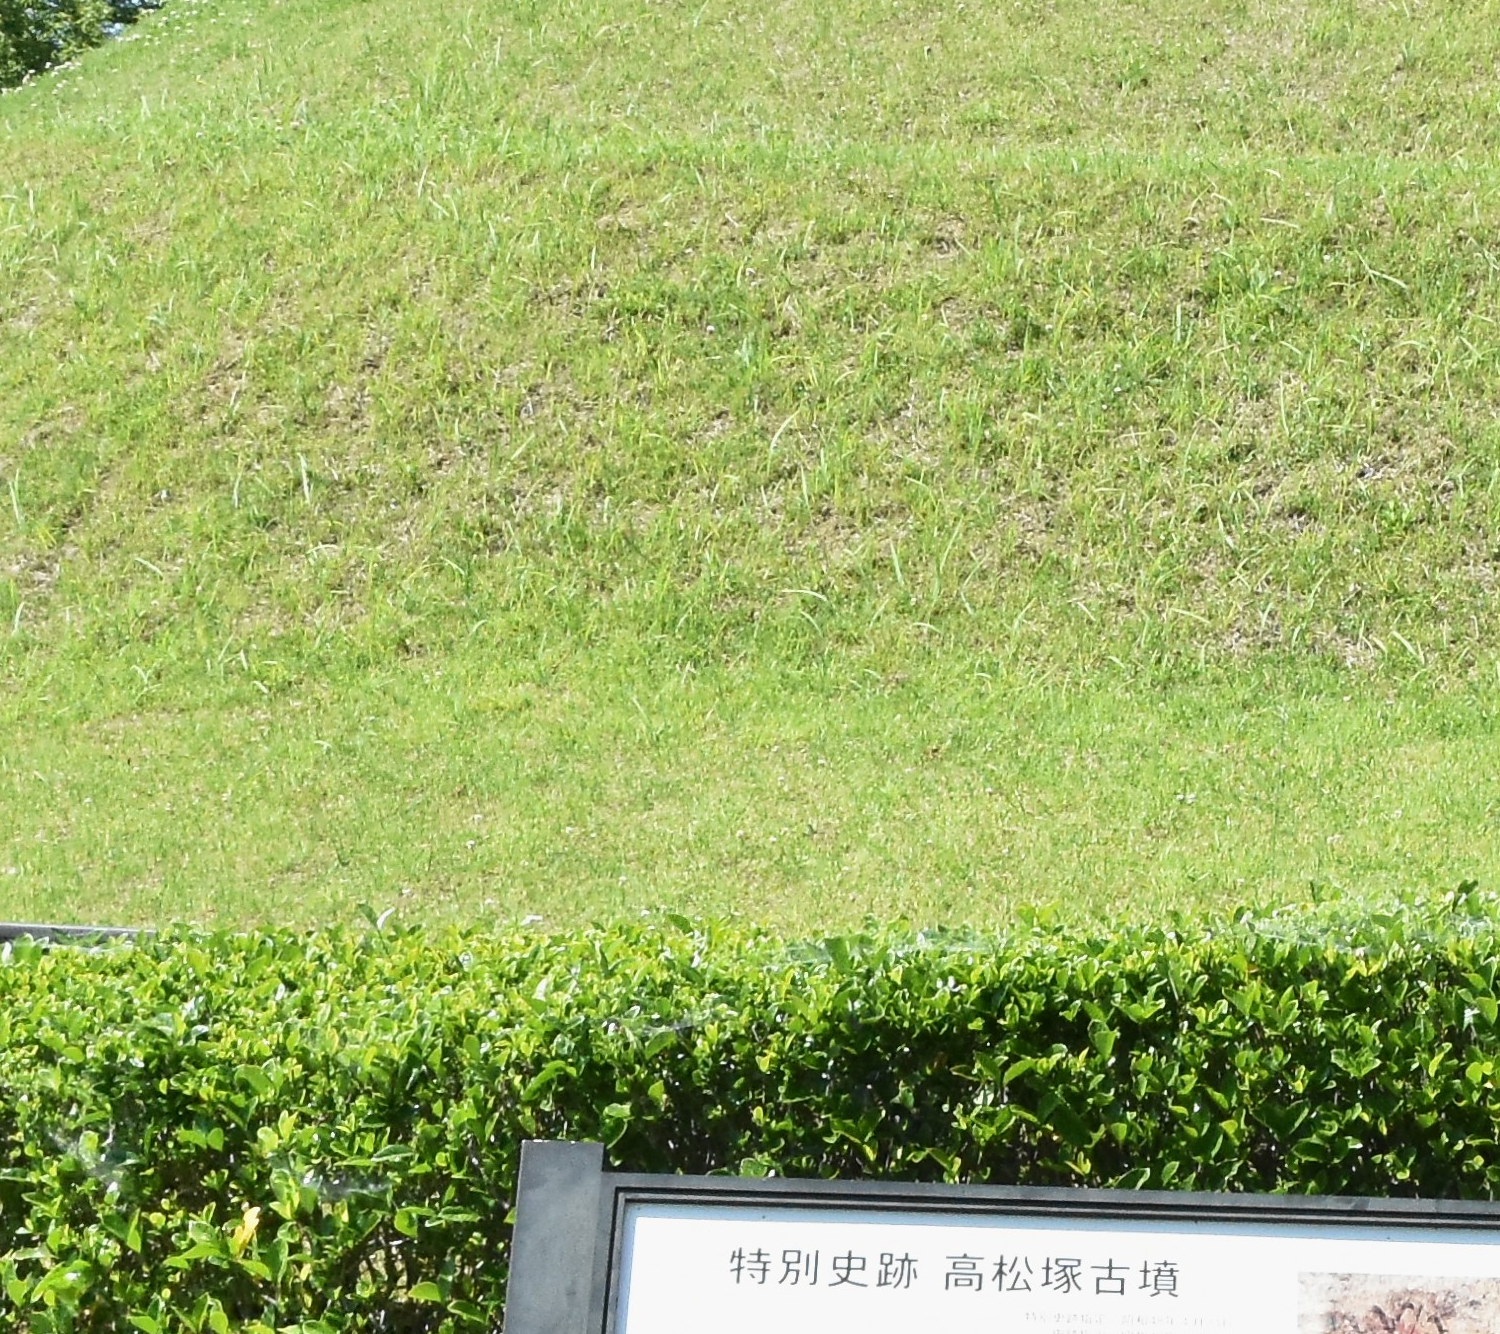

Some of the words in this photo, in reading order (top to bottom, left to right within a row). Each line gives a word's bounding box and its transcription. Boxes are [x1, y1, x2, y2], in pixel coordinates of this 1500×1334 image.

[729, 1246, 919, 1290] 特別史跡
[944, 1252, 1180, 1298] 高松塚古墳
